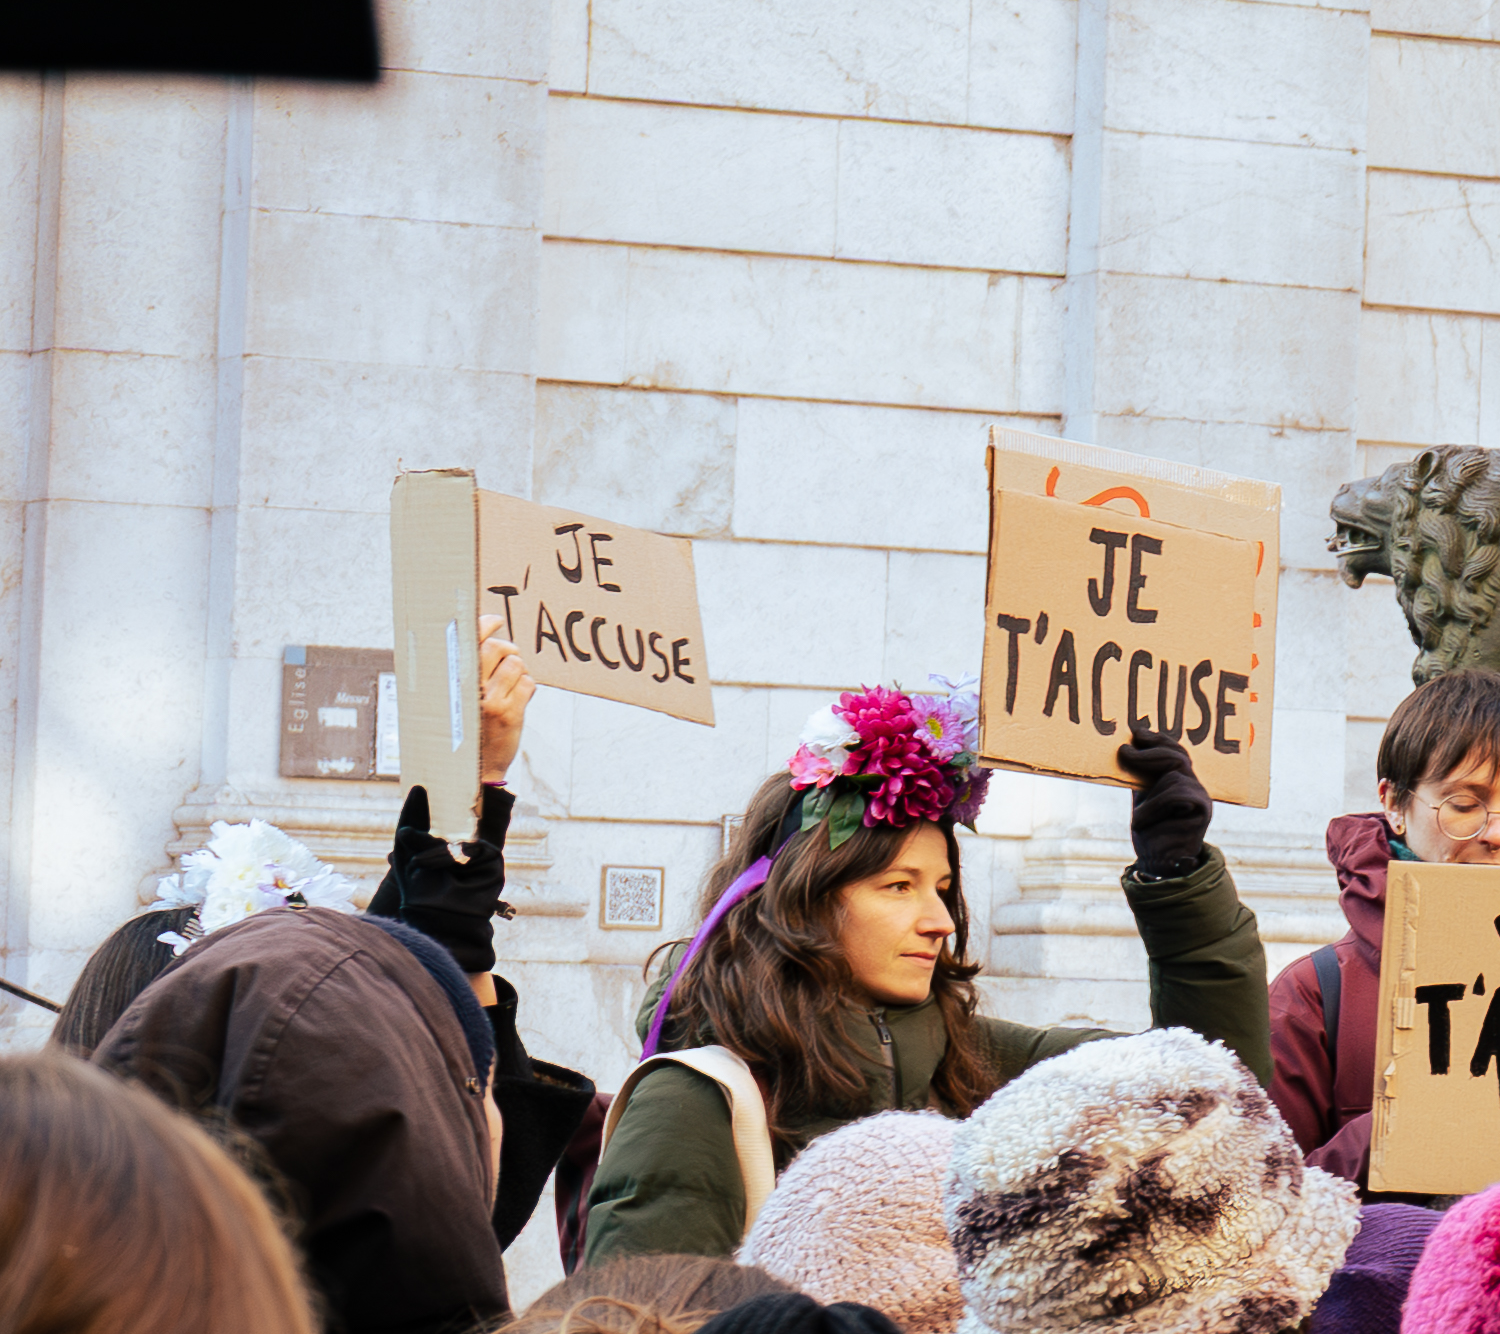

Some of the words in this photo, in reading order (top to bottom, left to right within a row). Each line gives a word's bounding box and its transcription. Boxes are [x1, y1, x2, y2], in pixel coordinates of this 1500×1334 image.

[554, 523, 622, 594] JE
[1087, 527, 1165, 624] JE
[487, 564, 697, 686] T'ACCUSE
[997, 610, 1250, 755] T'ACCUSE
